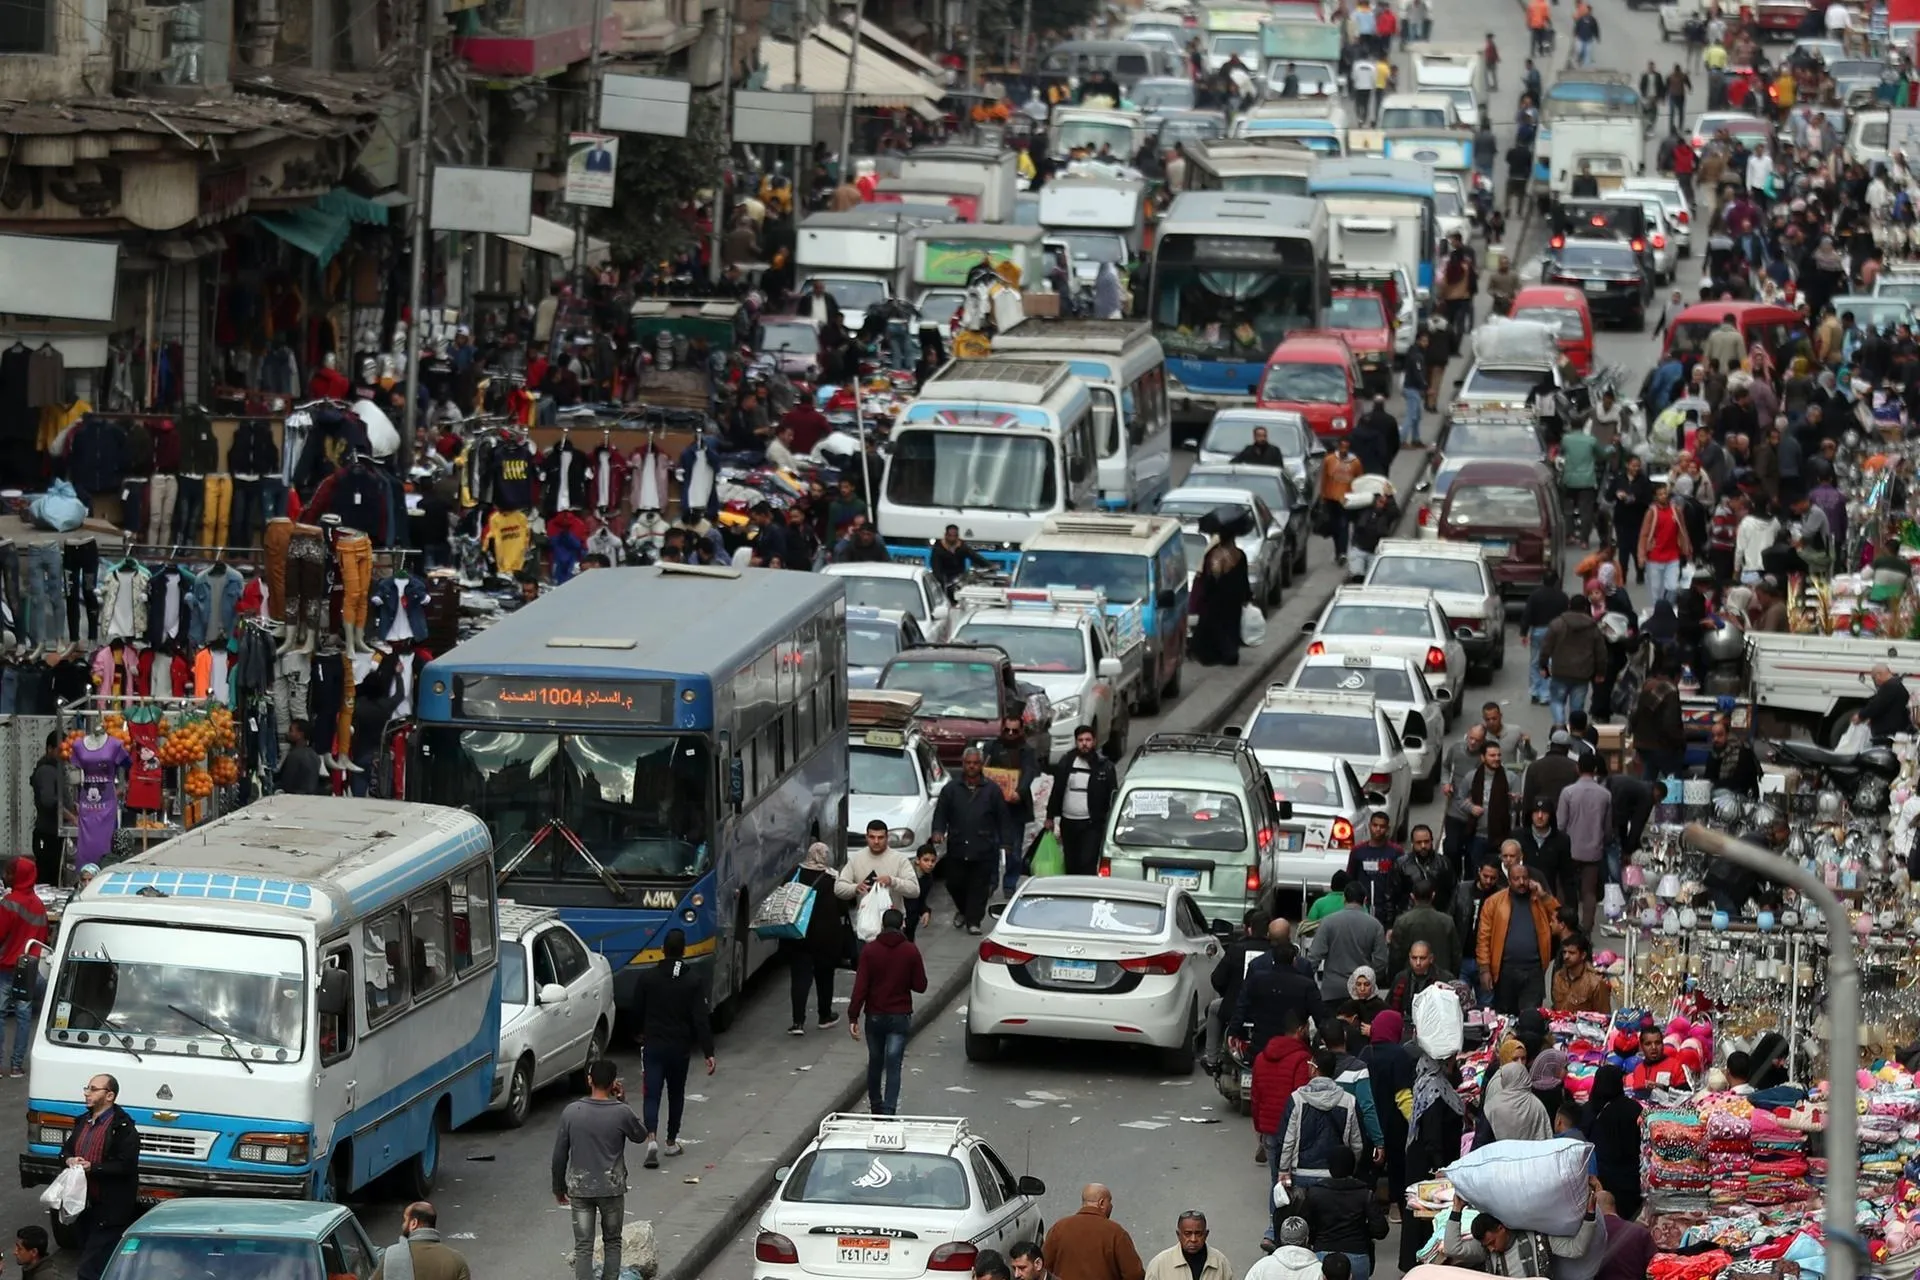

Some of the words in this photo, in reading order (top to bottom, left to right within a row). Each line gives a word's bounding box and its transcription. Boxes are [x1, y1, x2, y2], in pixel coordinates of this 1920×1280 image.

[539, 688, 582, 706] 1004
[643, 890, 678, 909] ٨٥٣٨
[873, 1135, 898, 1145] TAXI
[880, 1227, 903, 1238] ربنا
